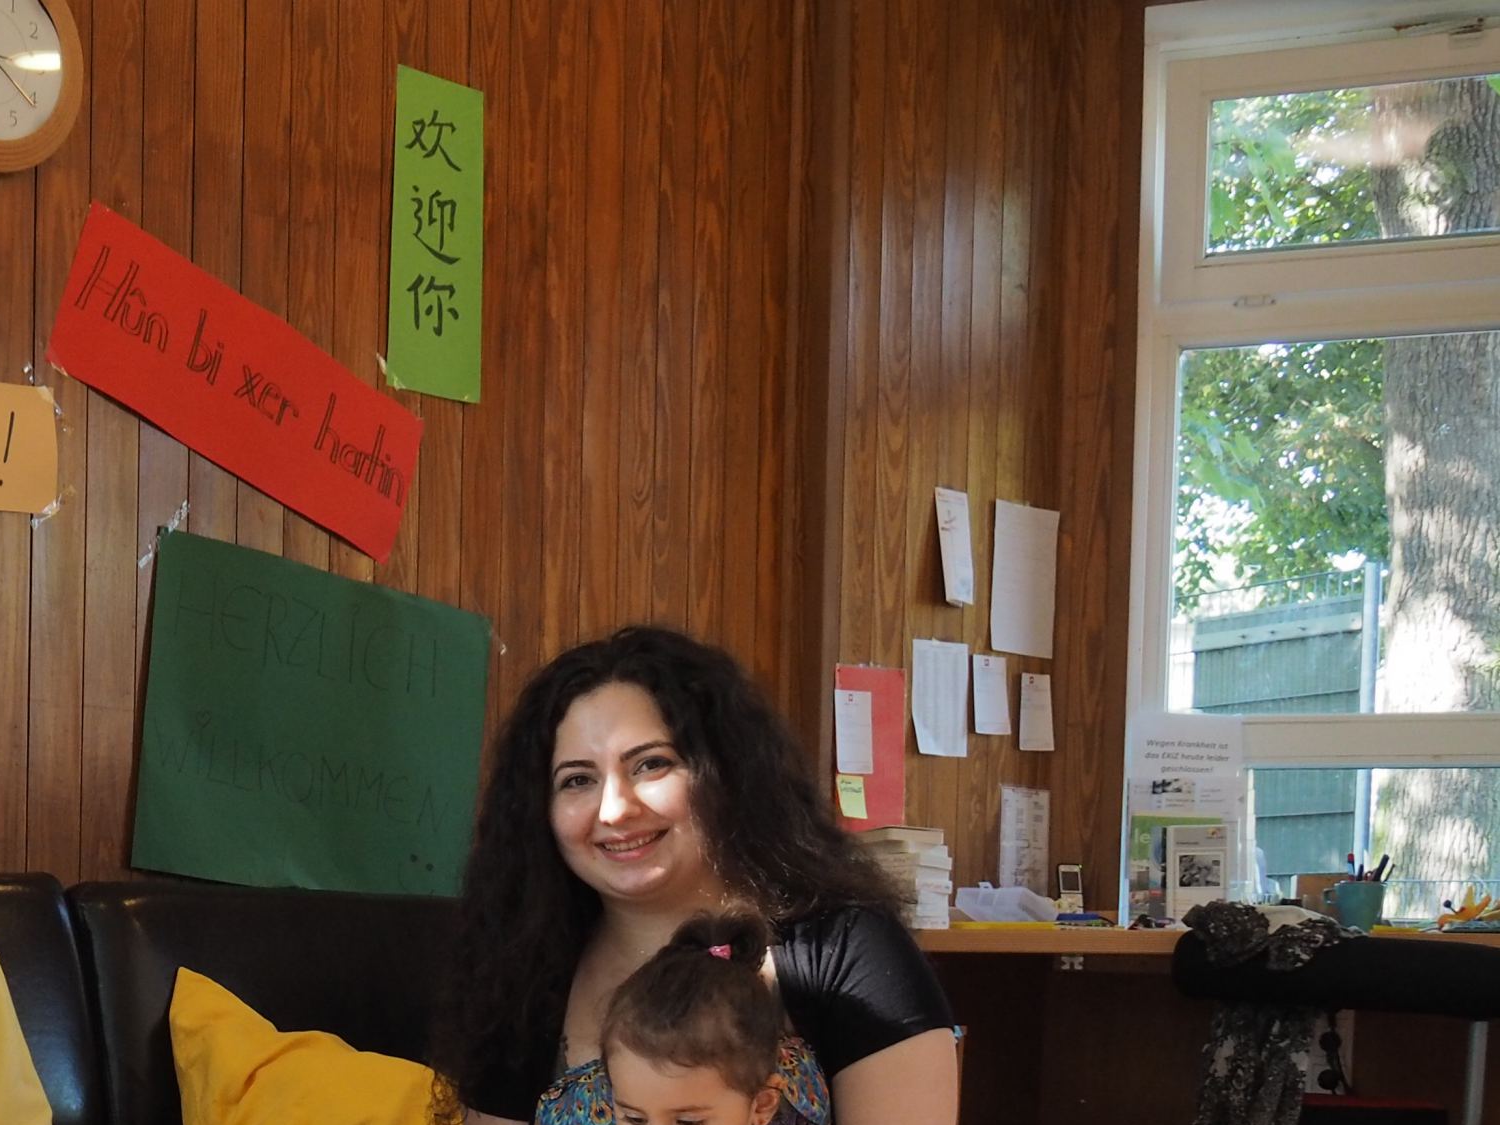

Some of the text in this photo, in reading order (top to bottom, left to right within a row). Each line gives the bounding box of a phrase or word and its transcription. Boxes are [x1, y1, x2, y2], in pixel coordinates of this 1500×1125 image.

[29, 21, 38, 40] 2
[9, 110, 18, 127] 5
[404, 109, 462, 337] 欢迎你
[185, 308, 226, 386] bi
[174, 570, 437, 698] HERZLICH
[153, 710, 451, 835] WILLKOMMEN
